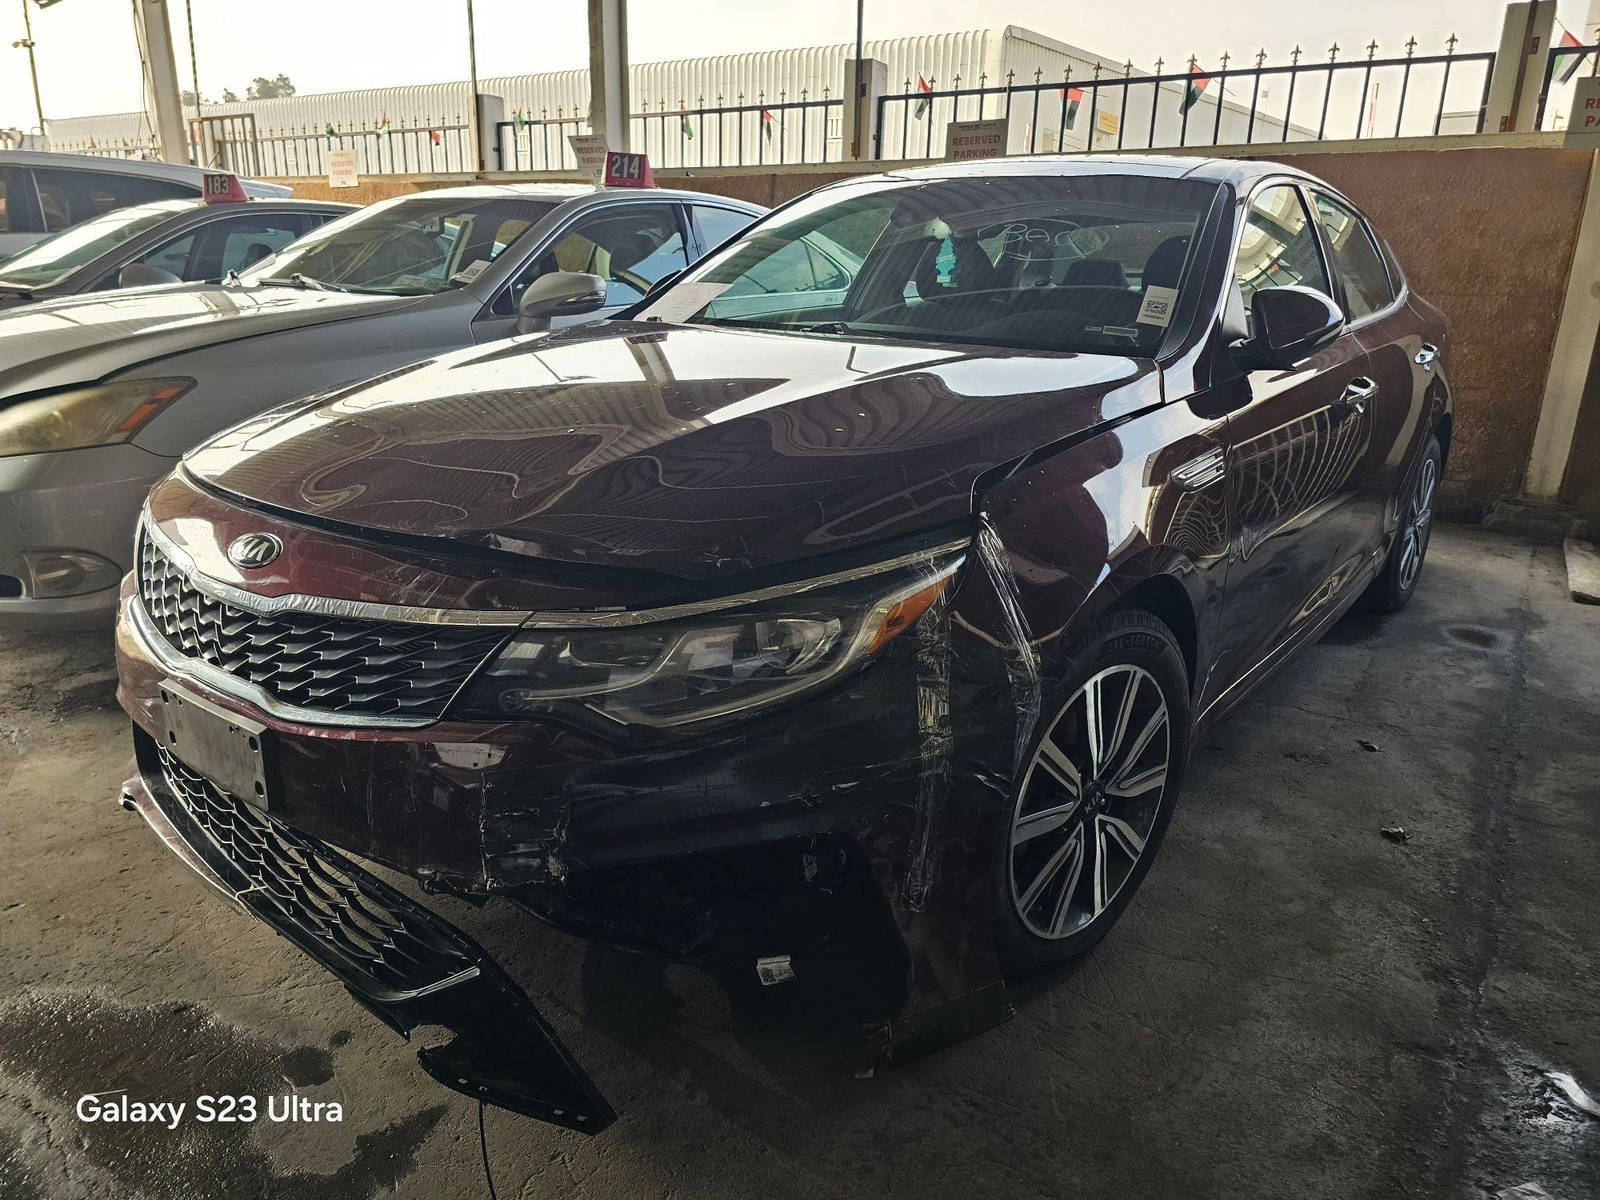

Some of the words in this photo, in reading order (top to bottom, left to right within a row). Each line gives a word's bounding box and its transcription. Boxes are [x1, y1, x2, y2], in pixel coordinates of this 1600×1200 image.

[952, 134, 1001, 146] RESERVED
[953, 148, 997, 160] PARKING
[611, 155, 640, 179] 214
[207, 175, 229, 194] 183
